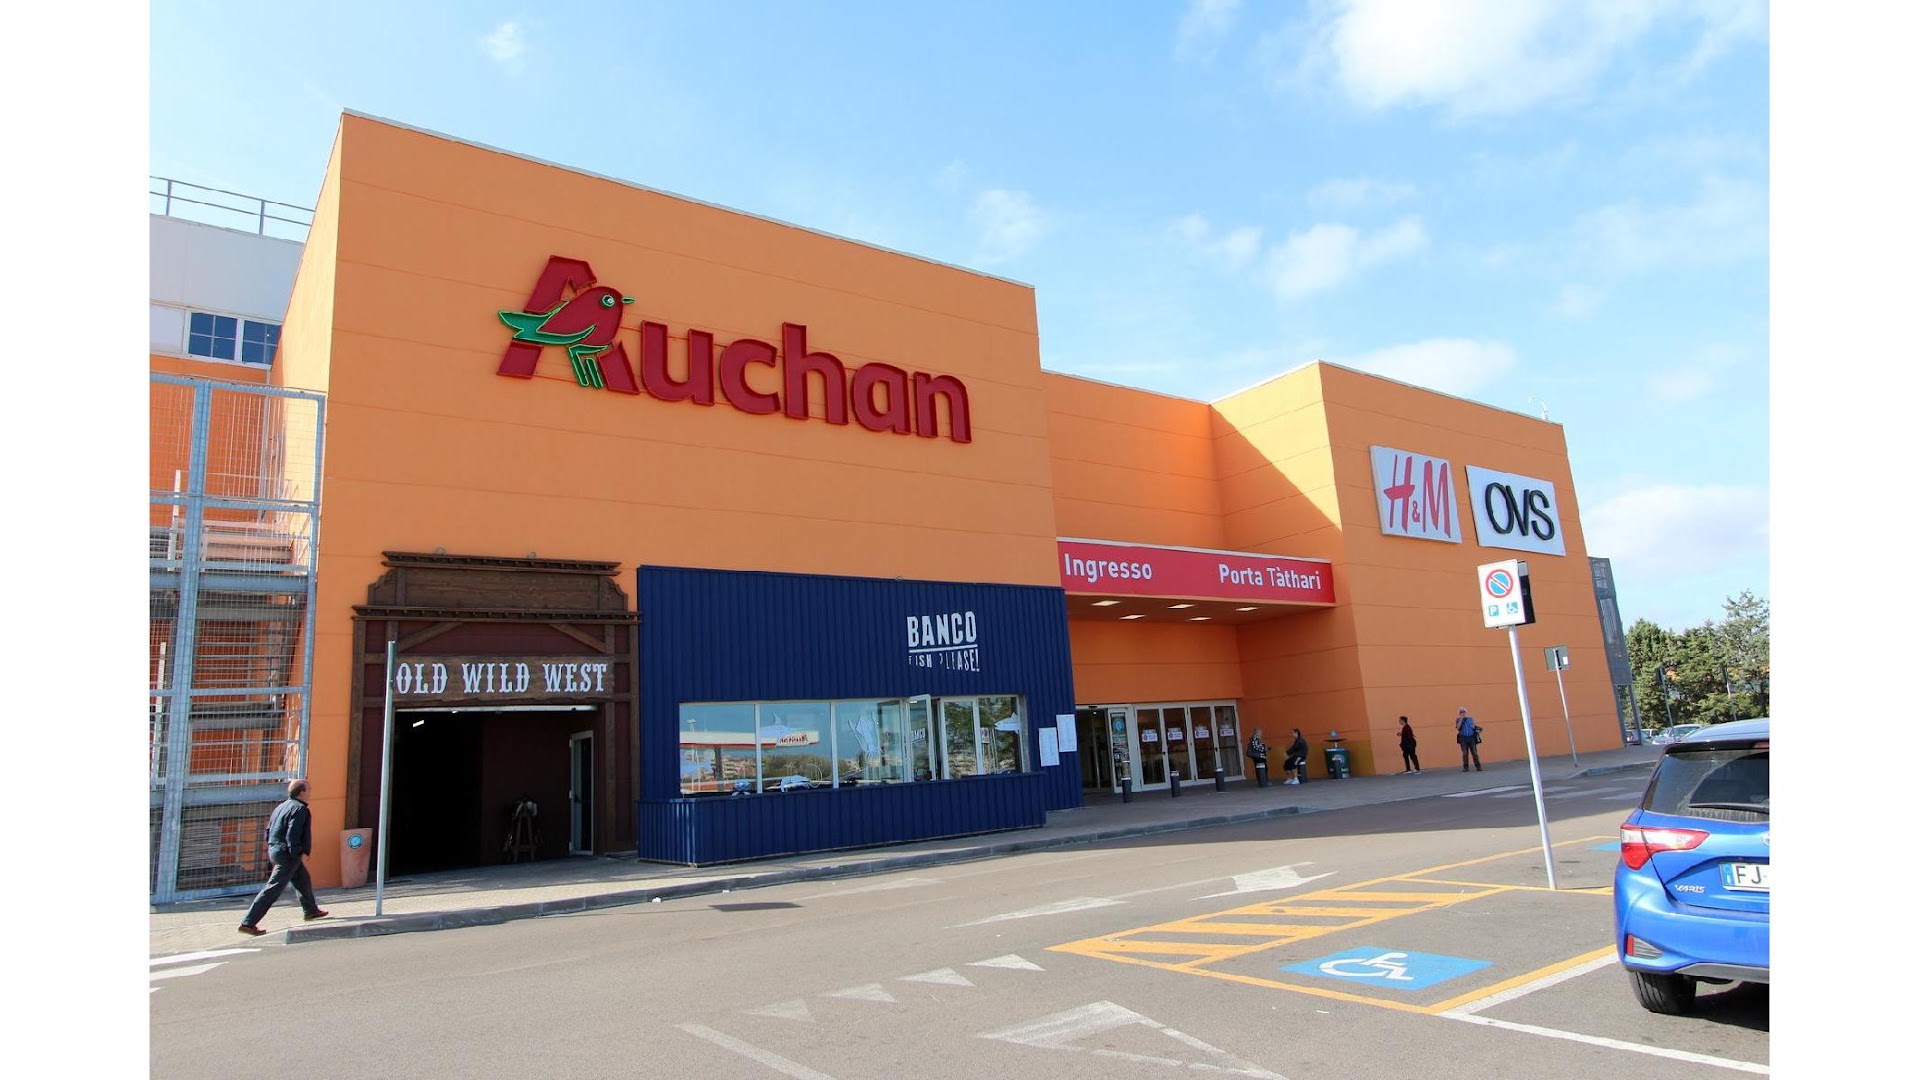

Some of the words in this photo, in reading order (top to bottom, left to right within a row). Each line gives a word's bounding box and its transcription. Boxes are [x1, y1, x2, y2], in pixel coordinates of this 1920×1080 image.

[496, 254, 973, 444] Auchan
[1383, 453, 1451, 539] H&M
[1484, 481, 1556, 541] OVS
[1063, 553, 1153, 583] Ingresso
[1218, 563, 1264, 587] Porta
[1266, 566, 1322, 590] Tàthari
[906, 611, 977, 648] BANCO
[908, 653, 933, 668] FISH
[395, 662, 449, 695] OLD
[461, 662, 531, 694] WILD
[542, 662, 608, 693] WEST
